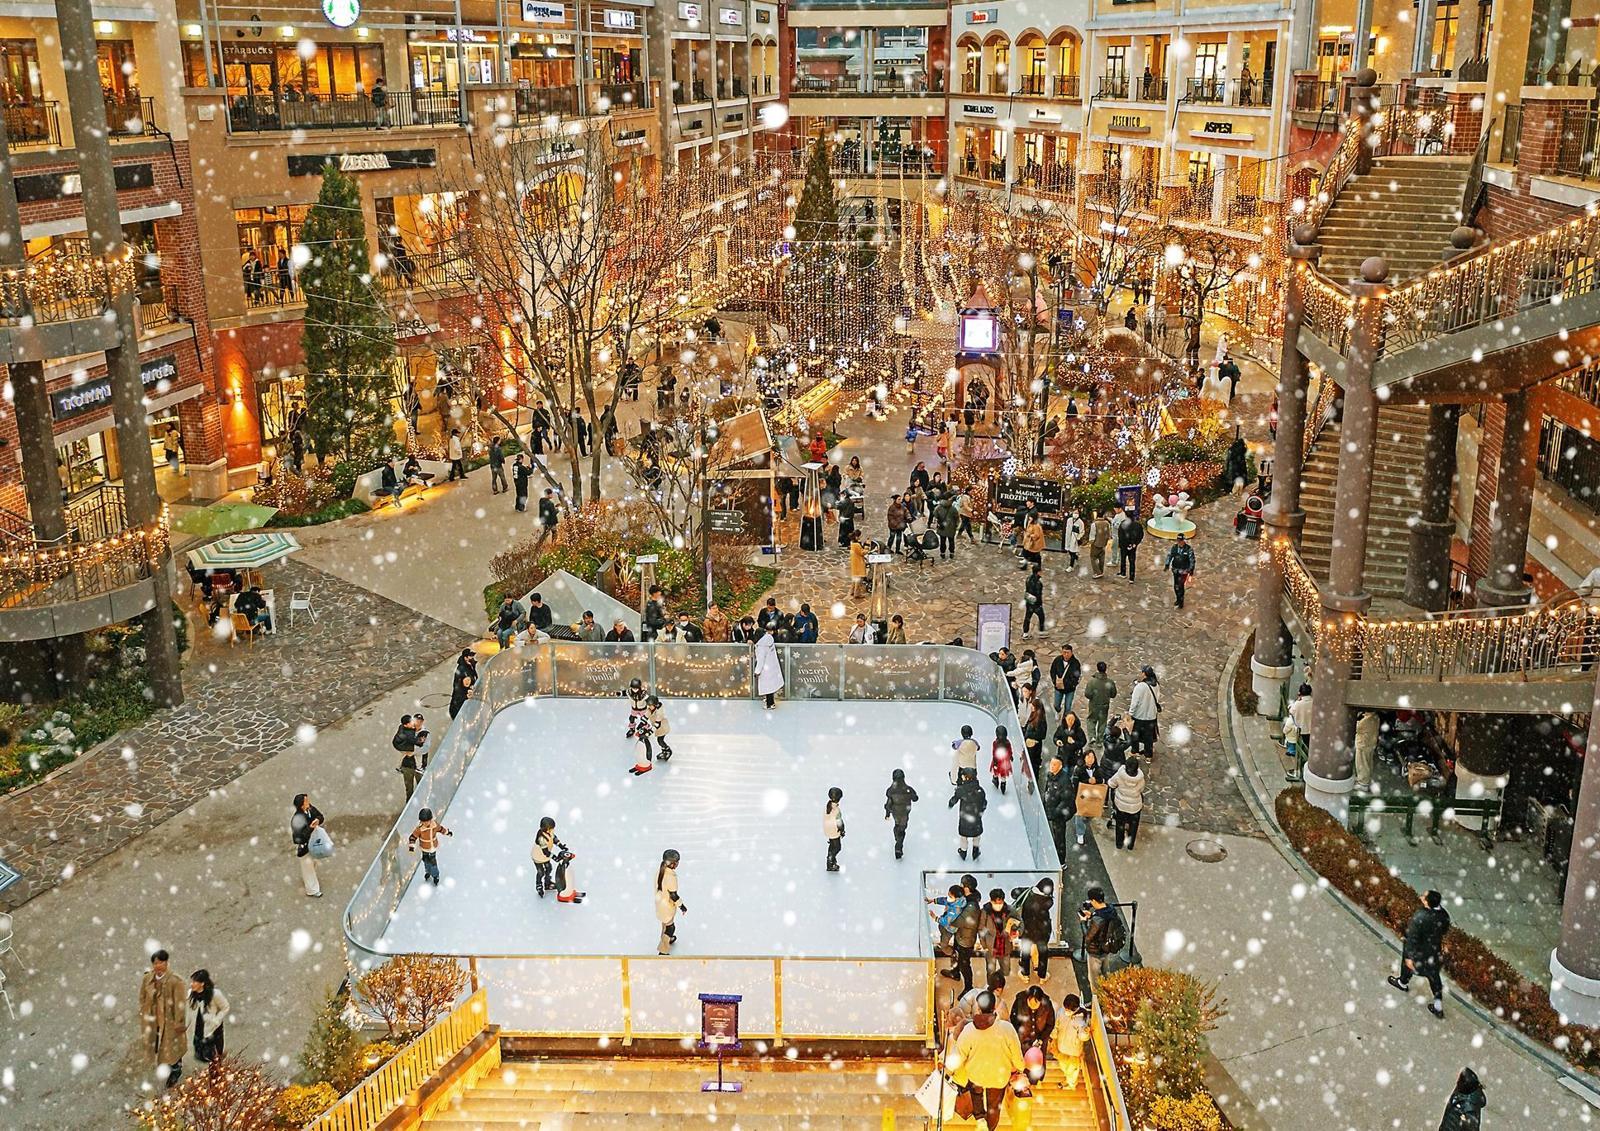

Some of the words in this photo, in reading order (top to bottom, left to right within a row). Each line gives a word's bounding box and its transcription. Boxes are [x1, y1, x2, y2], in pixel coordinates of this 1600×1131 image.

[1112, 115, 1141, 127] PESERICO
[1204, 121, 1232, 134] ASPESI
[60, 384, 112, 411] TOMMY
[1000, 492, 1028, 501] FROZEN
[1015, 489, 1044, 498] MAGICAL
